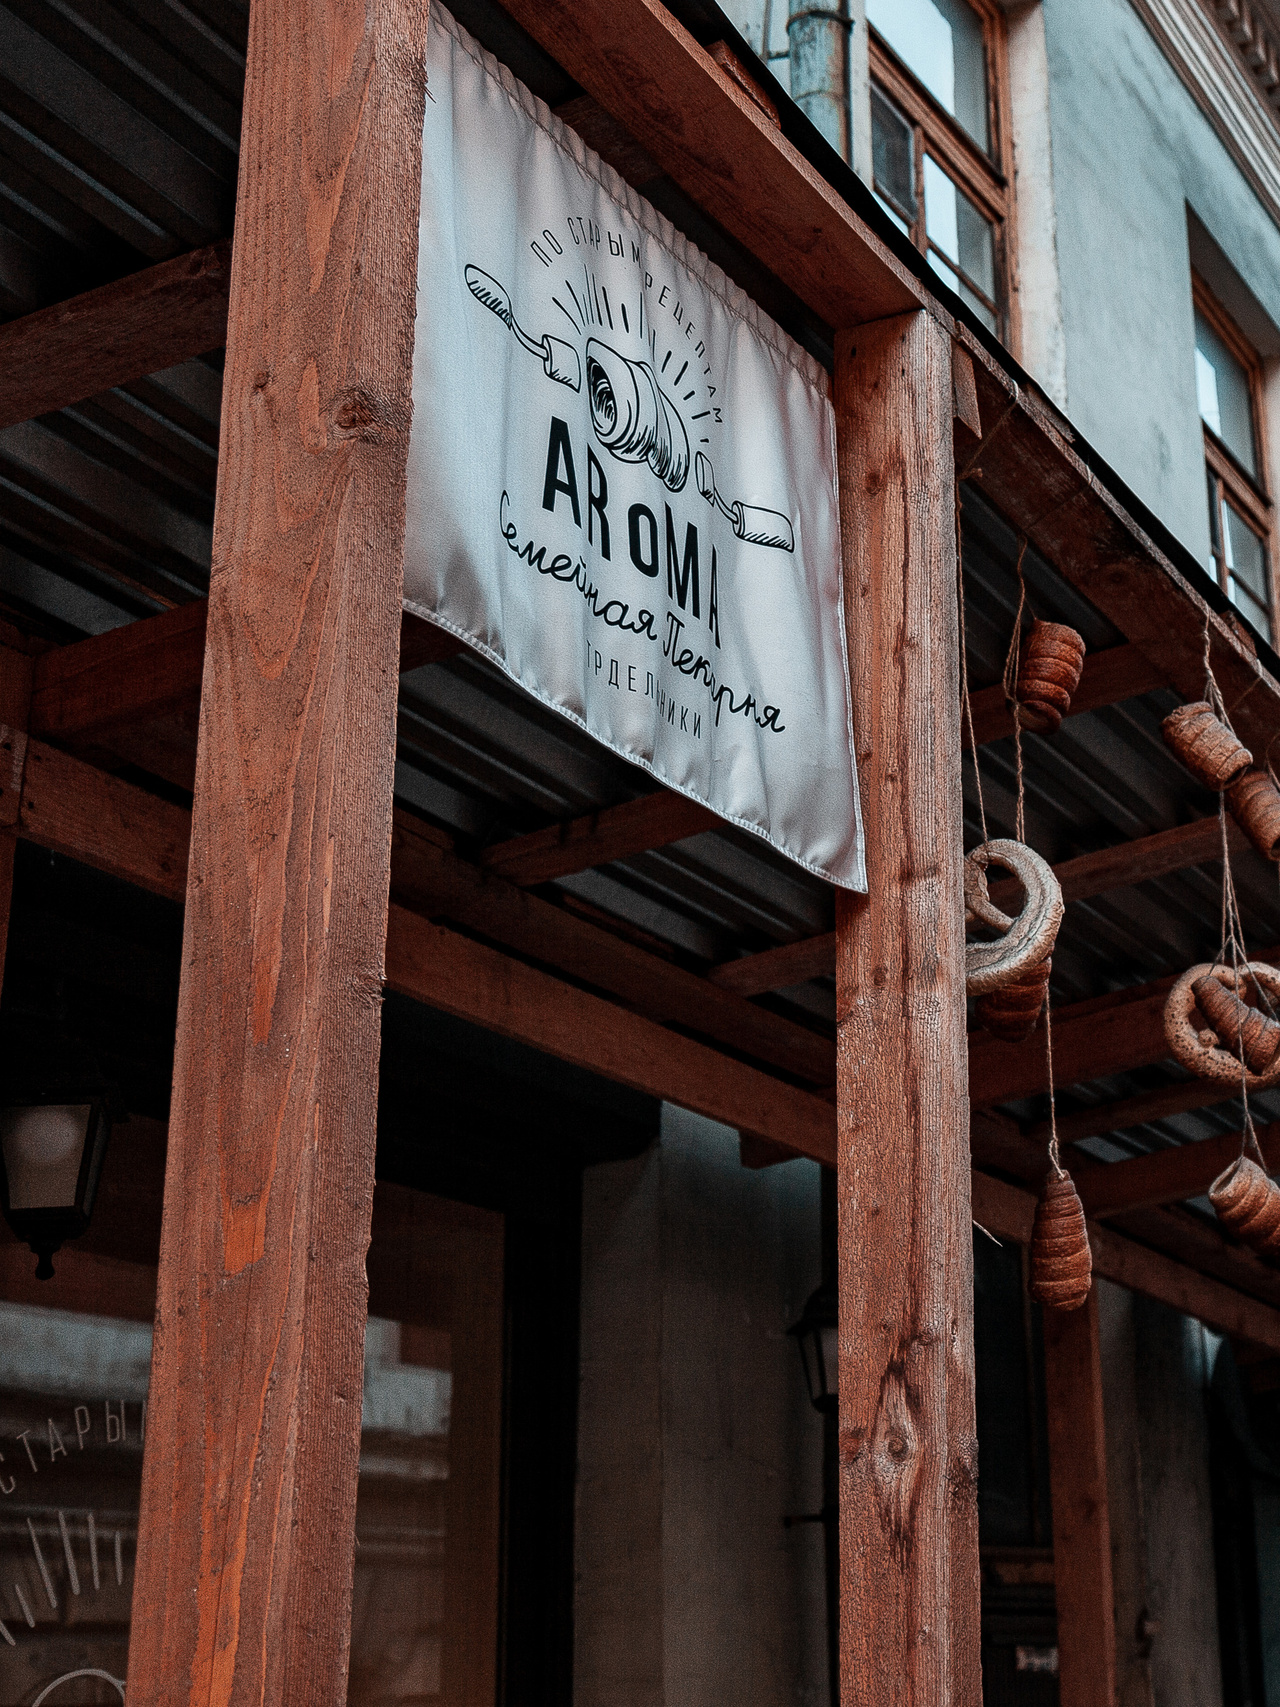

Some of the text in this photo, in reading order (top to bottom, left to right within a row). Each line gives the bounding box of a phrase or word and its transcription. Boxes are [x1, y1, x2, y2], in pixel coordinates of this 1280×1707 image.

[530, 216, 723, 423] ПО СТАРЫМ РЕЦЕПТАМ
[499, 489, 786, 733] Семейная Пекарня
[541, 415, 721, 650] AROMA
[586, 639, 702, 739] ТРДЕЛЬНИКИ
[0, 1399, 147, 1494] ТАРЫ
